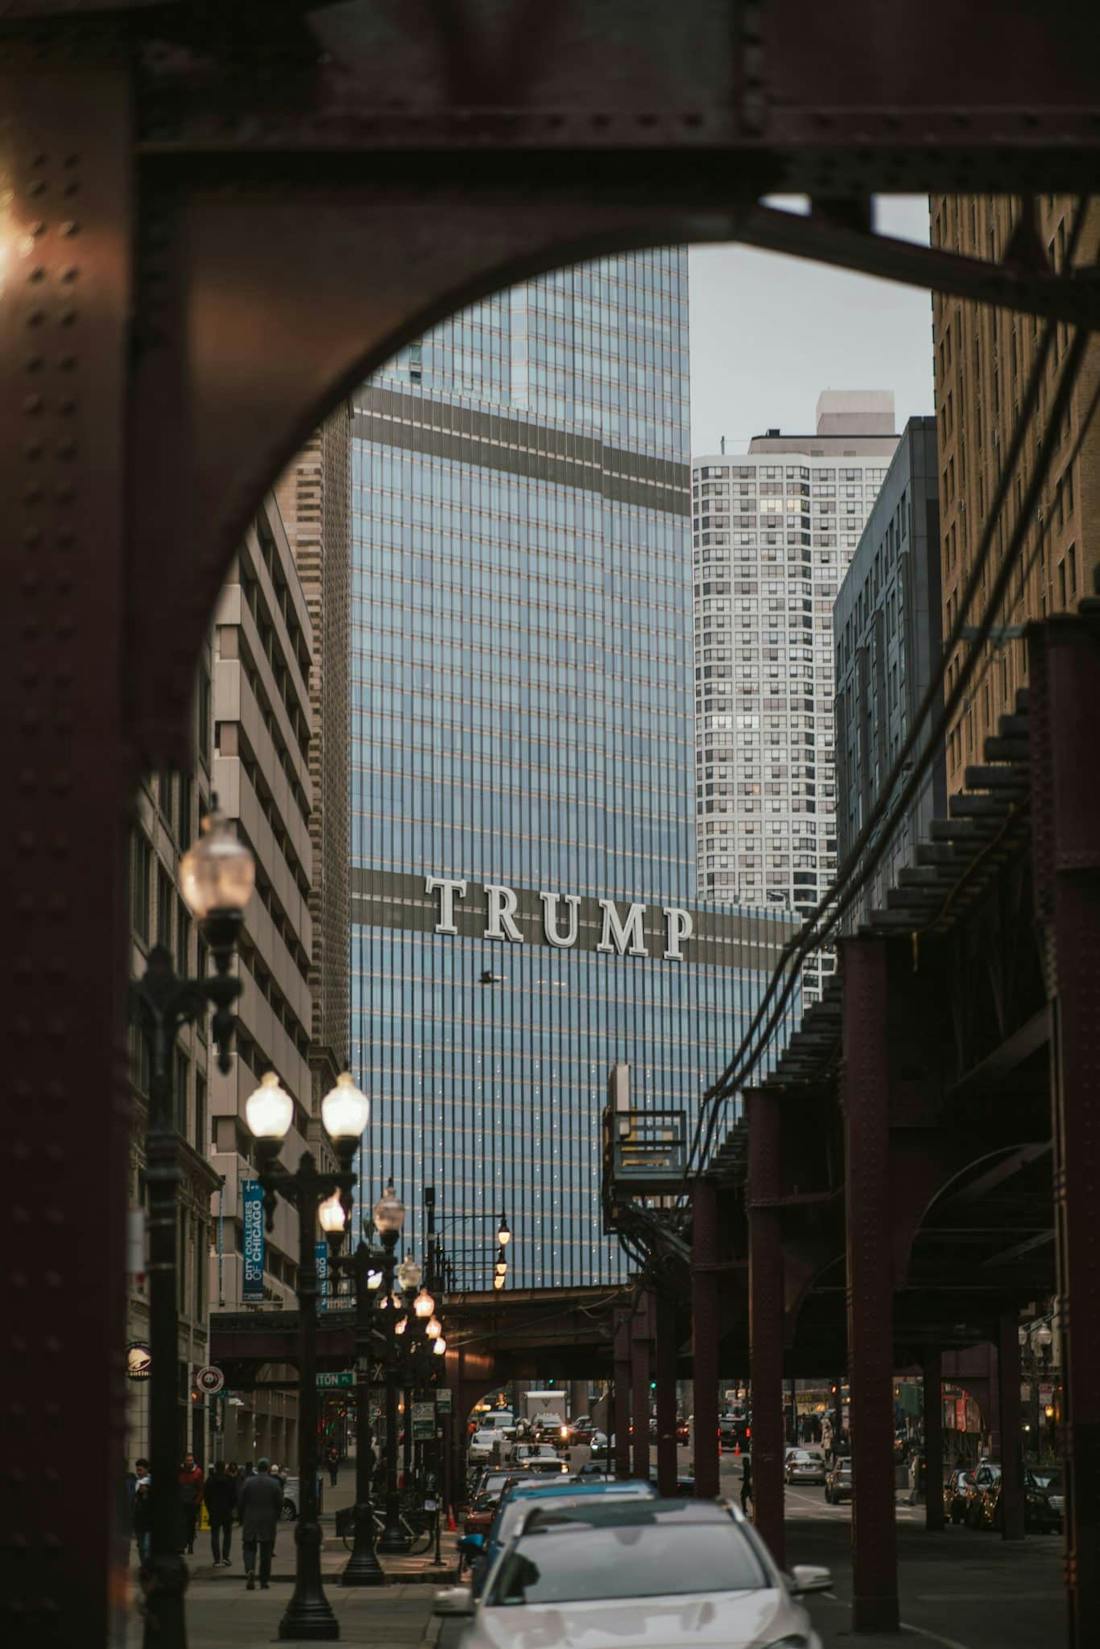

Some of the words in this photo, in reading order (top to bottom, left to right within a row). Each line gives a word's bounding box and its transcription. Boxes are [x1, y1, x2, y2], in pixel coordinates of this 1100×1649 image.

[425, 875, 693, 961] TRUMP
[245, 1201, 253, 1255] COLLEGES
[252, 1200, 262, 1262] CHICAGO
[245, 1258, 253, 1281] CITY
[252, 1265, 262, 1281] OF
